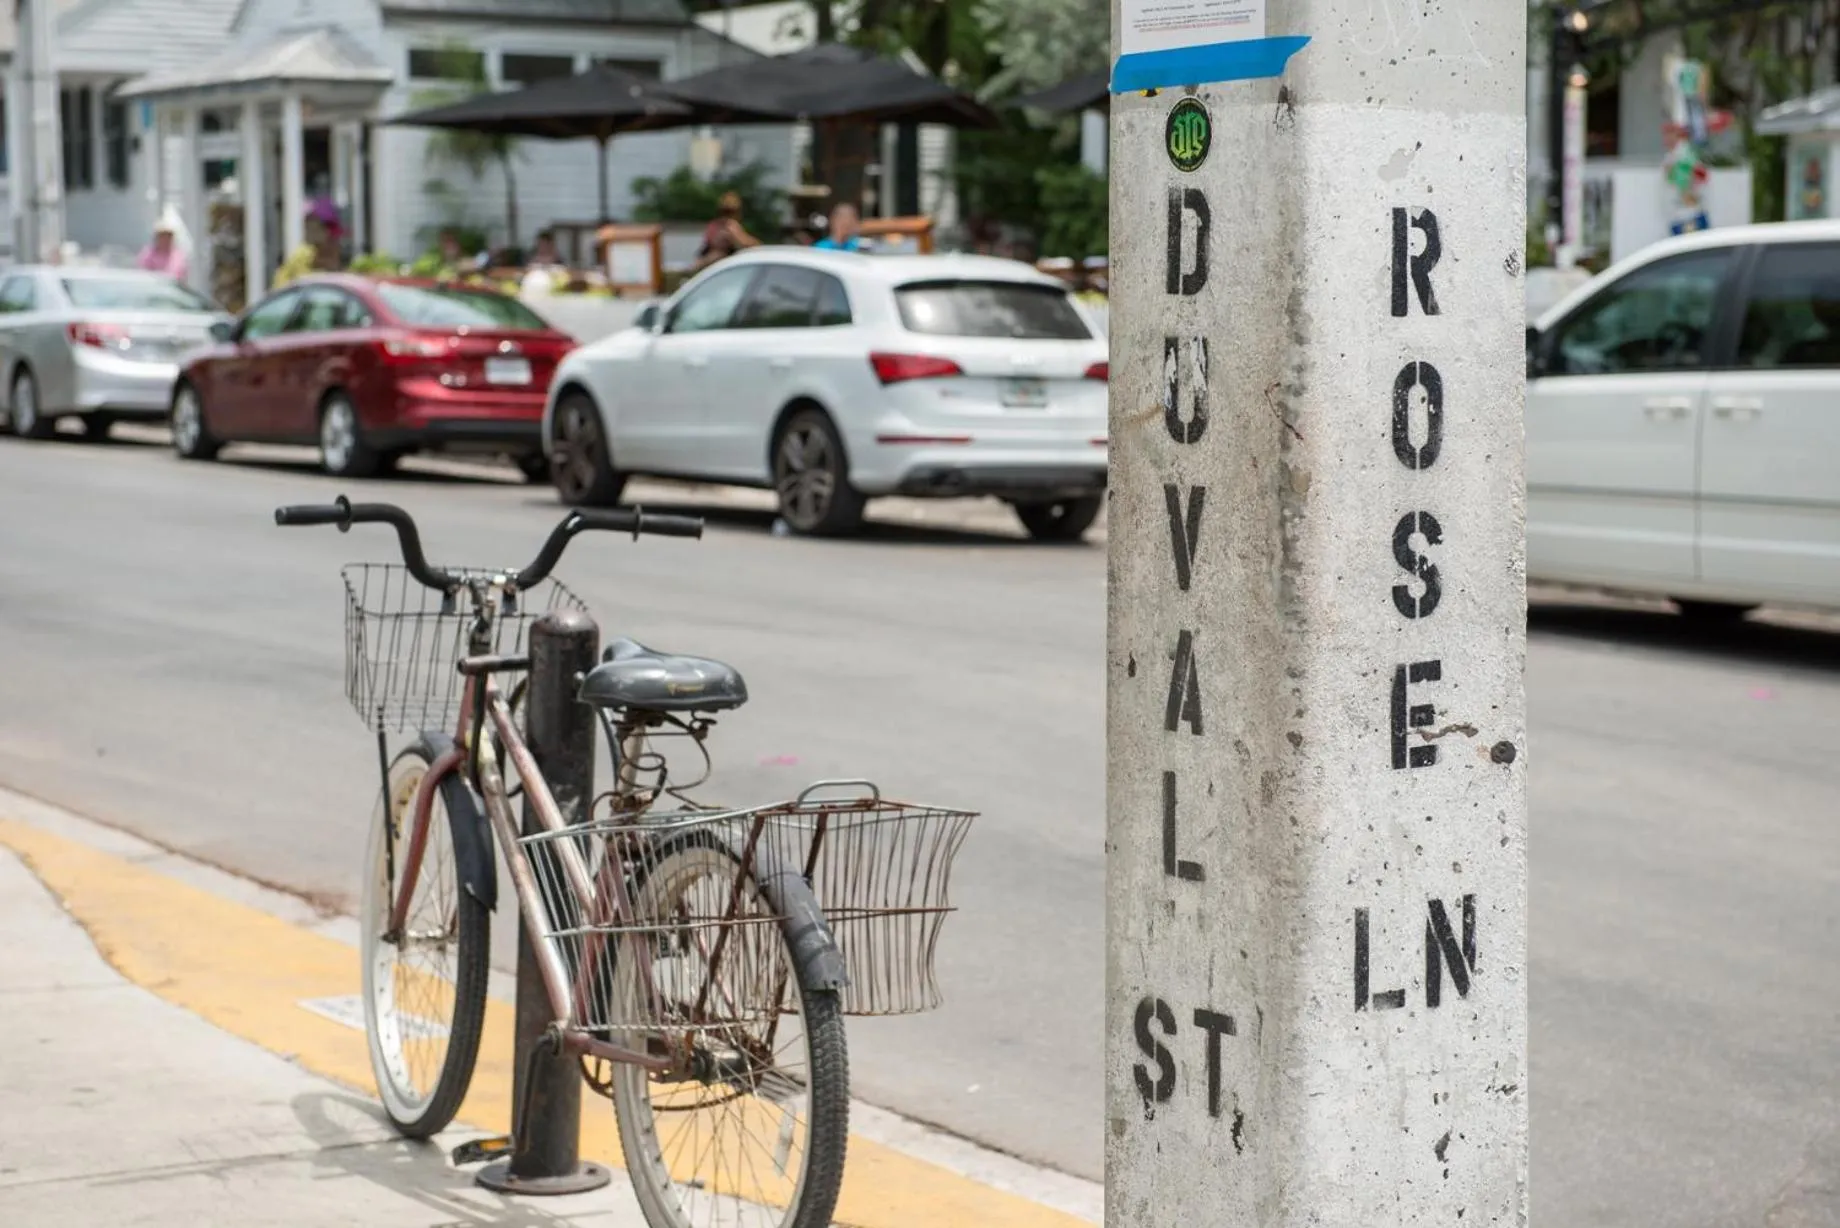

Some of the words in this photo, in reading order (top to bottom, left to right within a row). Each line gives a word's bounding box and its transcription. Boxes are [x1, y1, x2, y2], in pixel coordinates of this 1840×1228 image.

[1164, 187, 1210, 882] DUVAL
[1390, 206, 1443, 769] ROSE
[1133, 997, 1237, 1118] ST
[1354, 894, 1476, 1012] LN
